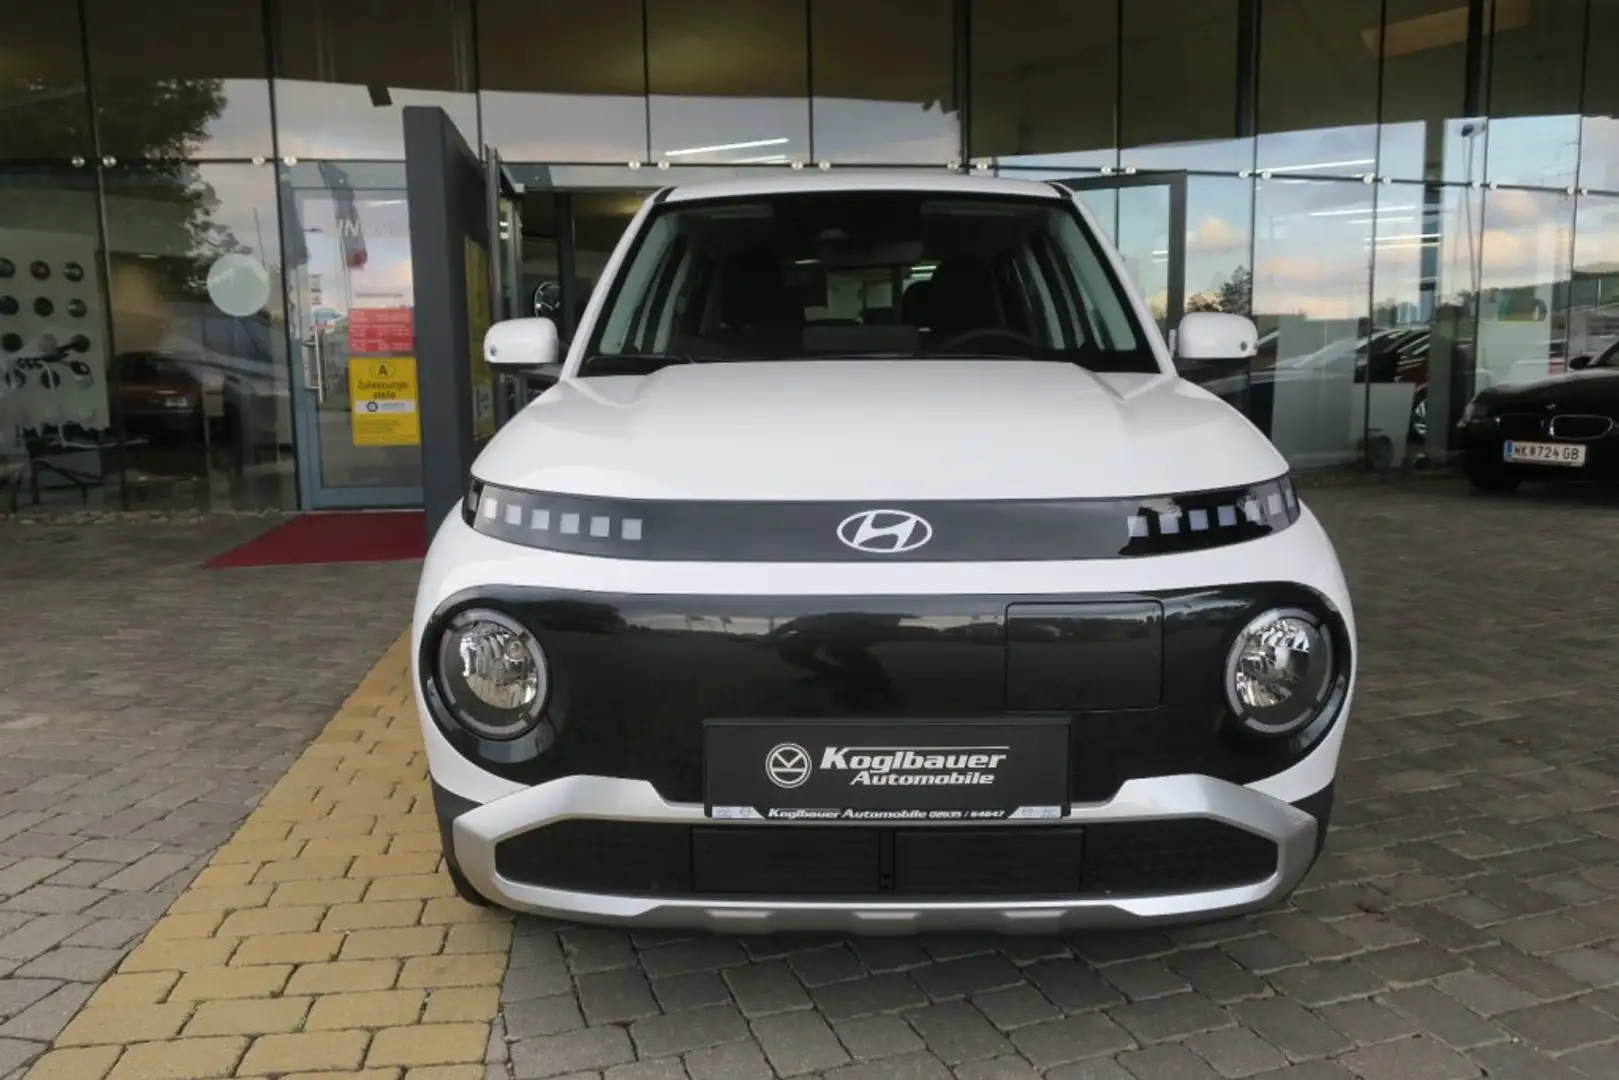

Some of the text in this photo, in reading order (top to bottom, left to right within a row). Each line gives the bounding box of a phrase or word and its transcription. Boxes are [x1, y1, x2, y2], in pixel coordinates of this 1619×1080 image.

[378, 364, 388, 376] A
[1537, 446, 1560, 459] 724
[820, 746, 1008, 774] Koglbauer
[849, 771, 994, 786] Automobile
[768, 808, 840, 819] Koglbauer
[841, 808, 927, 819] Automobile
